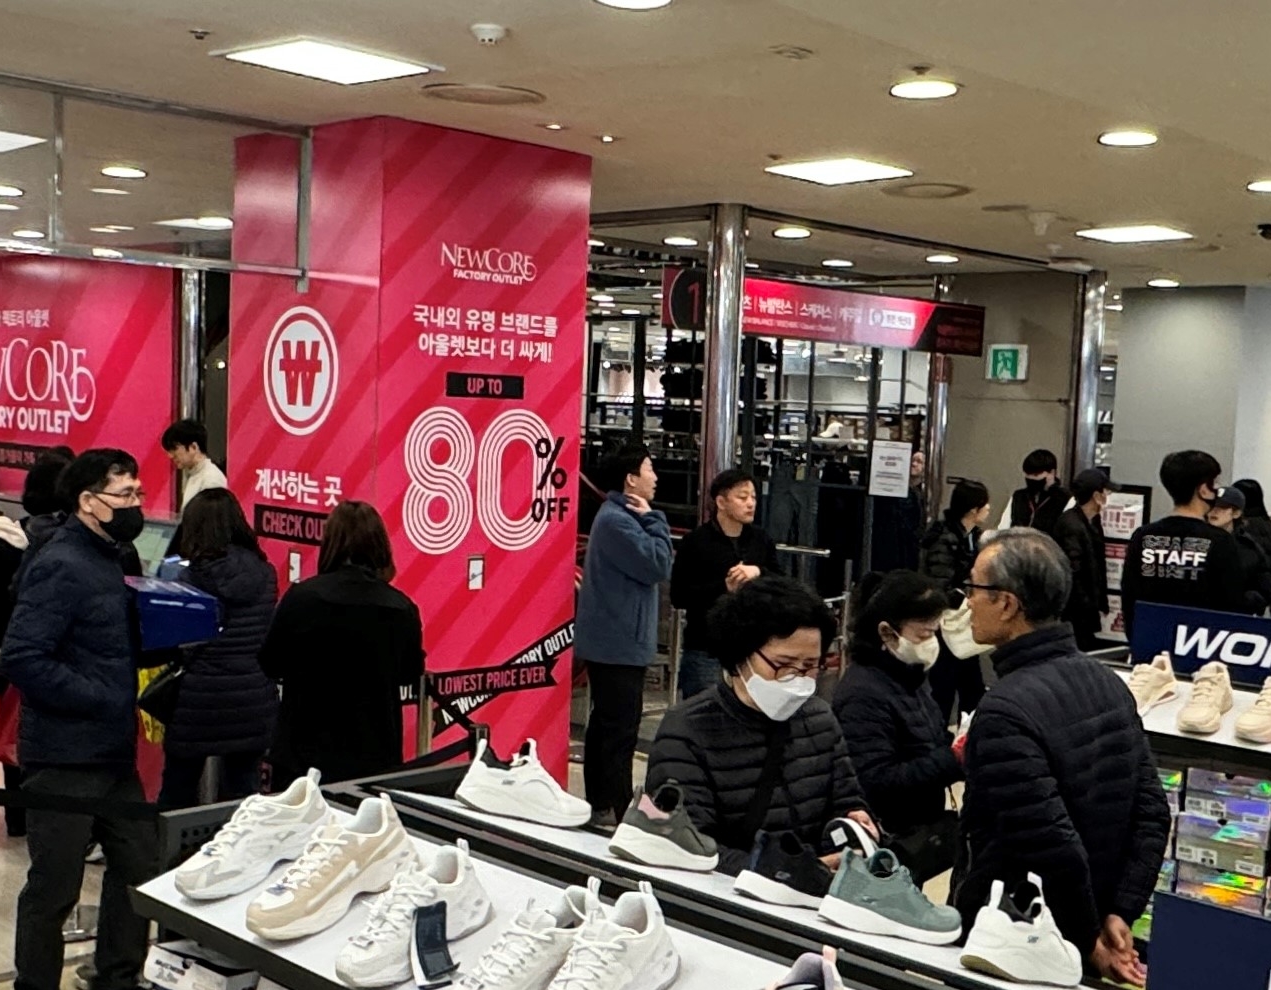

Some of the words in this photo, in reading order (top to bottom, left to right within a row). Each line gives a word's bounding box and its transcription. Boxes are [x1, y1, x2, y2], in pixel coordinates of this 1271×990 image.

[440, 242, 537, 281] NEWCORE
[453, 268, 492, 283] FACTORY
[492, 271, 525, 286] OUTLET
[413, 304, 461, 330] 국내외
[465, 309, 496, 333] 유명
[499, 312, 559, 338] 브랜드를
[418, 333, 497, 360] 아울렛보다
[500, 339, 515, 361] 더
[518, 341, 553, 364] 싸게!
[467, 376, 485, 394] UP
[487, 378, 503, 395] TO
[17, 406, 73, 434] OUTLET
[255, 468, 320, 503] 계산하는
[323, 475, 343, 507] 곳
[262, 509, 303, 537] CHECK
[530, 497, 571, 523] OFF
[1141, 549, 1208, 567] STAFF
[544, 623, 575, 656] OUTLE
[438, 672, 484, 696] LOWEST
[486, 668, 518, 689] PRICE
[519, 665, 547, 684] EVER
